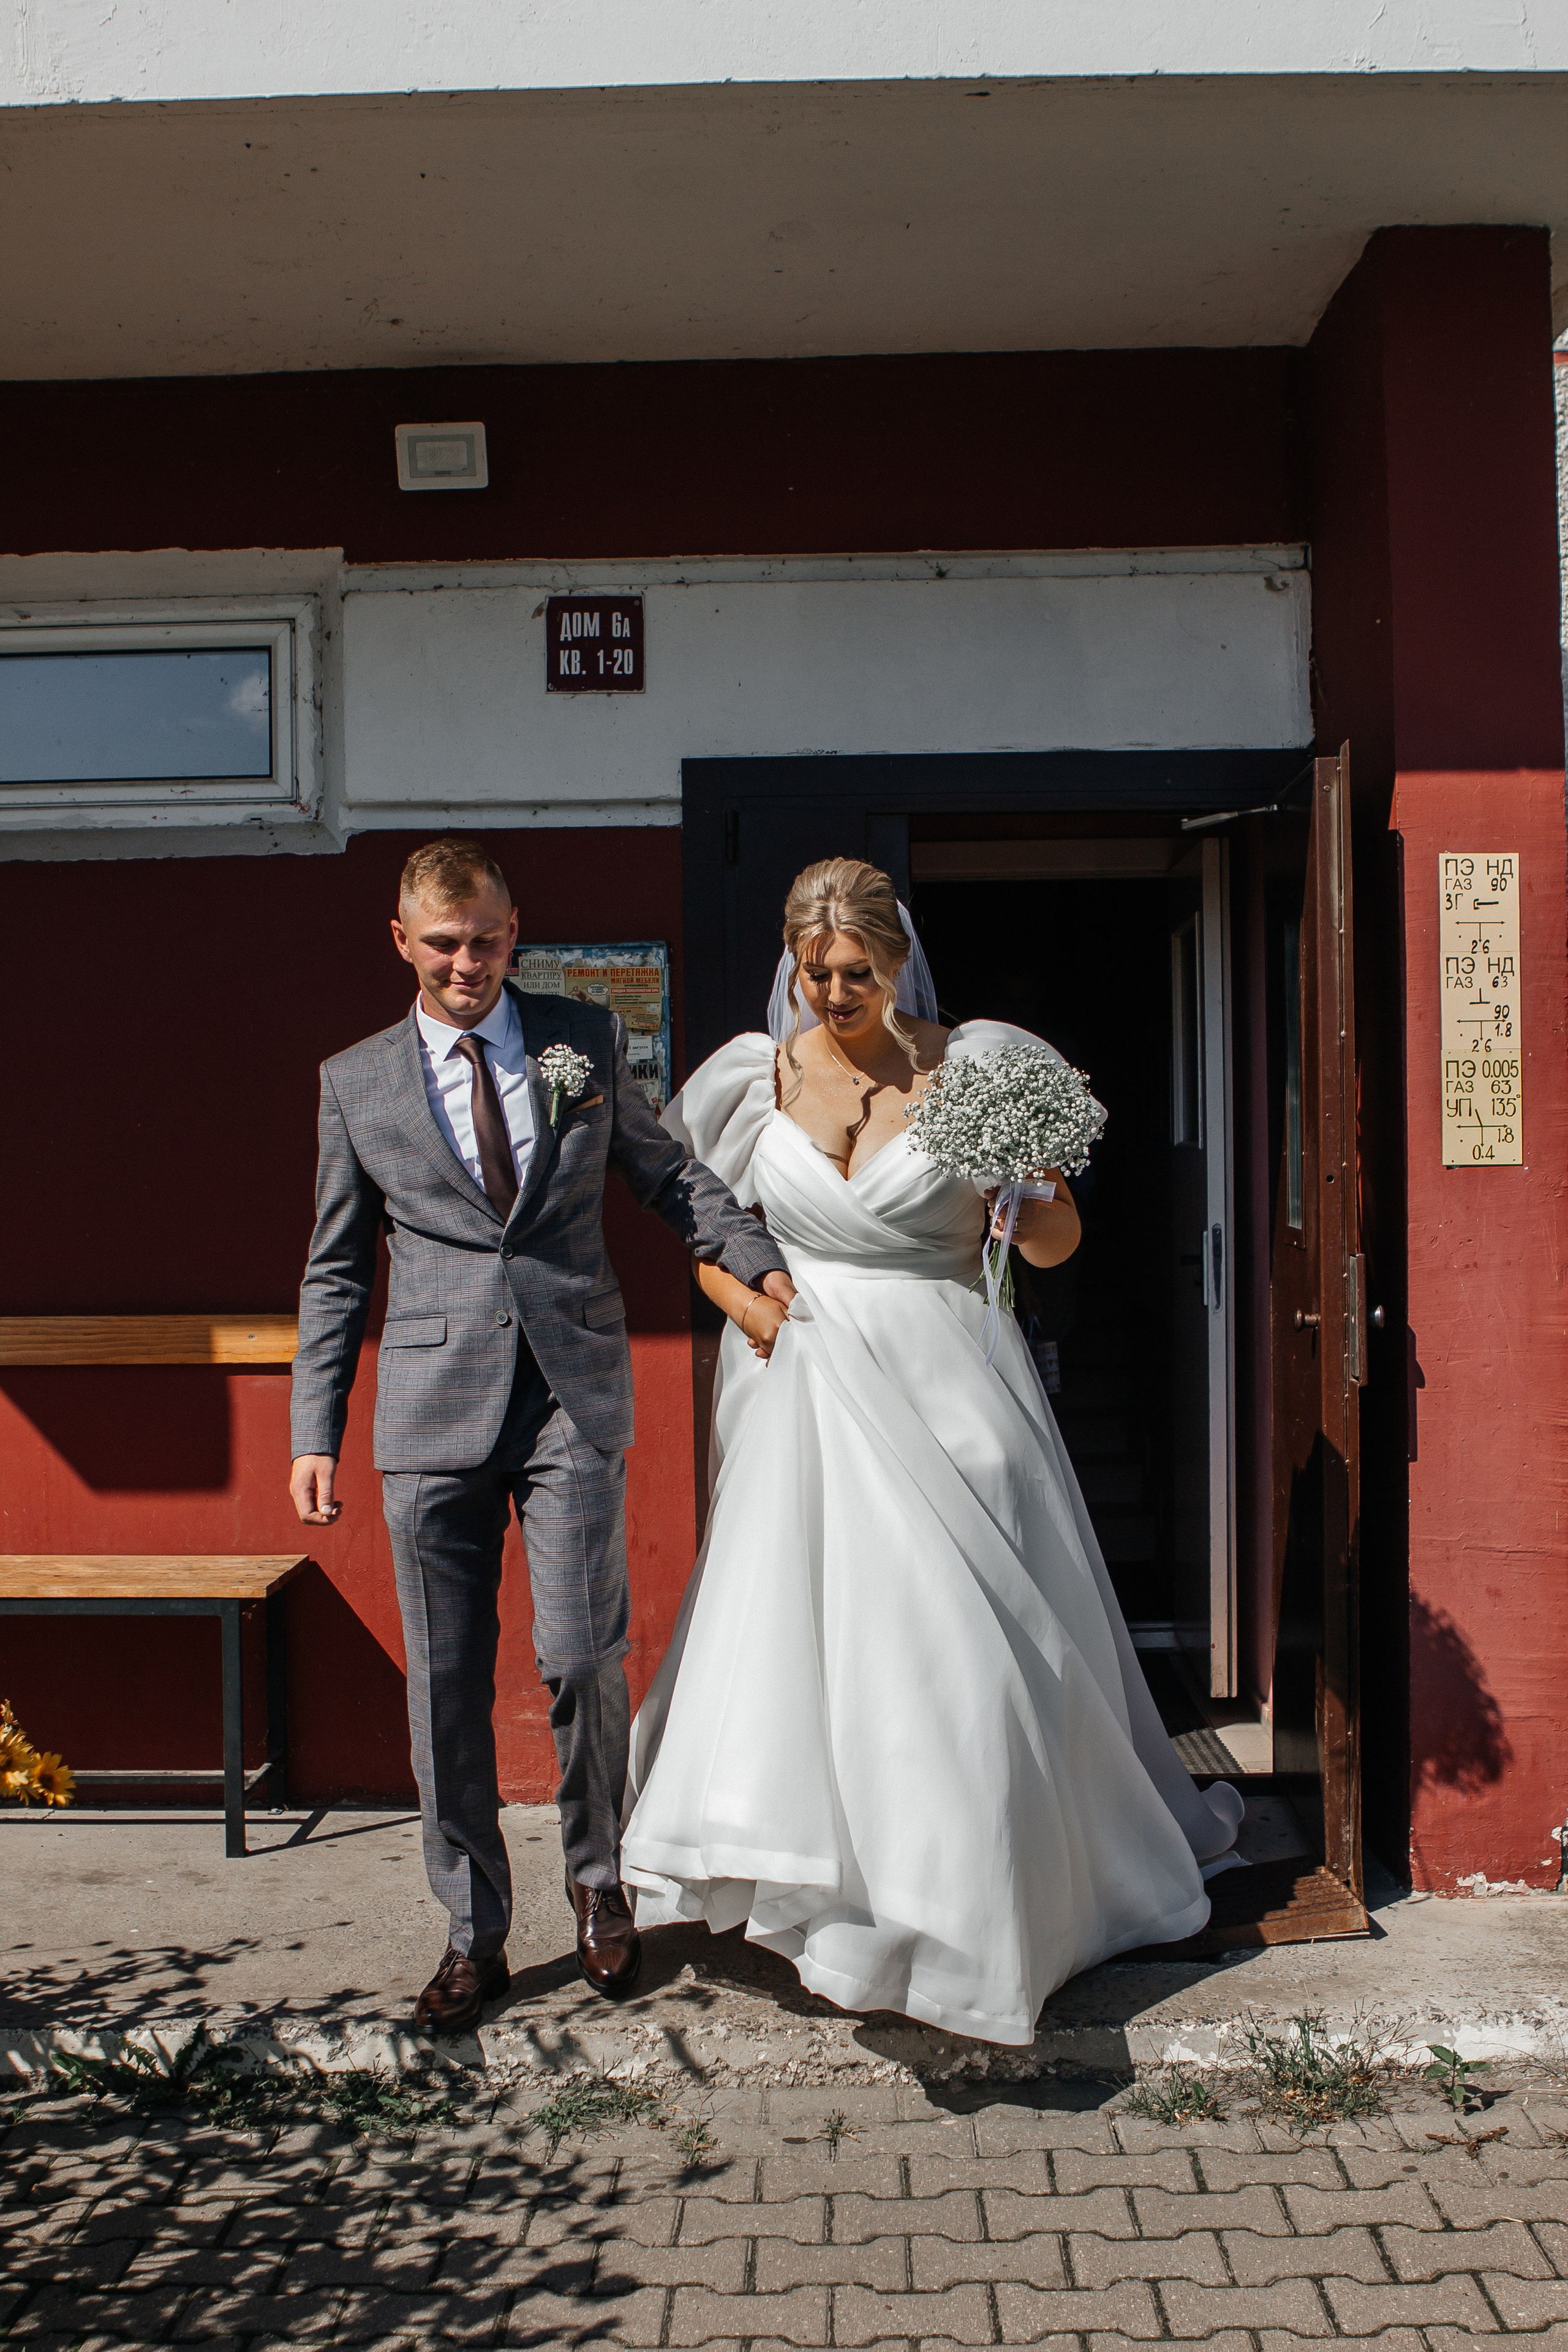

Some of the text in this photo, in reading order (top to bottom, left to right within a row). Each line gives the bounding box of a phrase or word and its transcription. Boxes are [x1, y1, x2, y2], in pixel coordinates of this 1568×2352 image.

[560, 612, 600, 641] ДОМ
[560, 649, 633, 675] КВ. 1-20
[1445, 858, 1513, 879] ПЭ НД
[1445, 878, 1507, 892] ГАЗ 90
[521, 959, 560, 970] СНИМУ
[1446, 957, 1515, 977] ПЭ НД
[567, 968, 660, 978] РЕМОНТ И ПЕРЕТЯЖКА
[1446, 976, 1508, 989] ГАЗ 63
[1494, 1005, 1510, 1020] 90
[1495, 1022, 1512, 1038] 1.8
[1446, 1060, 1519, 1079] ПЭ 0.005
[1446, 1080, 1512, 1095] ГАЗ 63
[1447, 1098, 1471, 1117] УП
[1498, 1127, 1514, 1144] 1.8
[1472, 1145, 1495, 1160] 0.4
